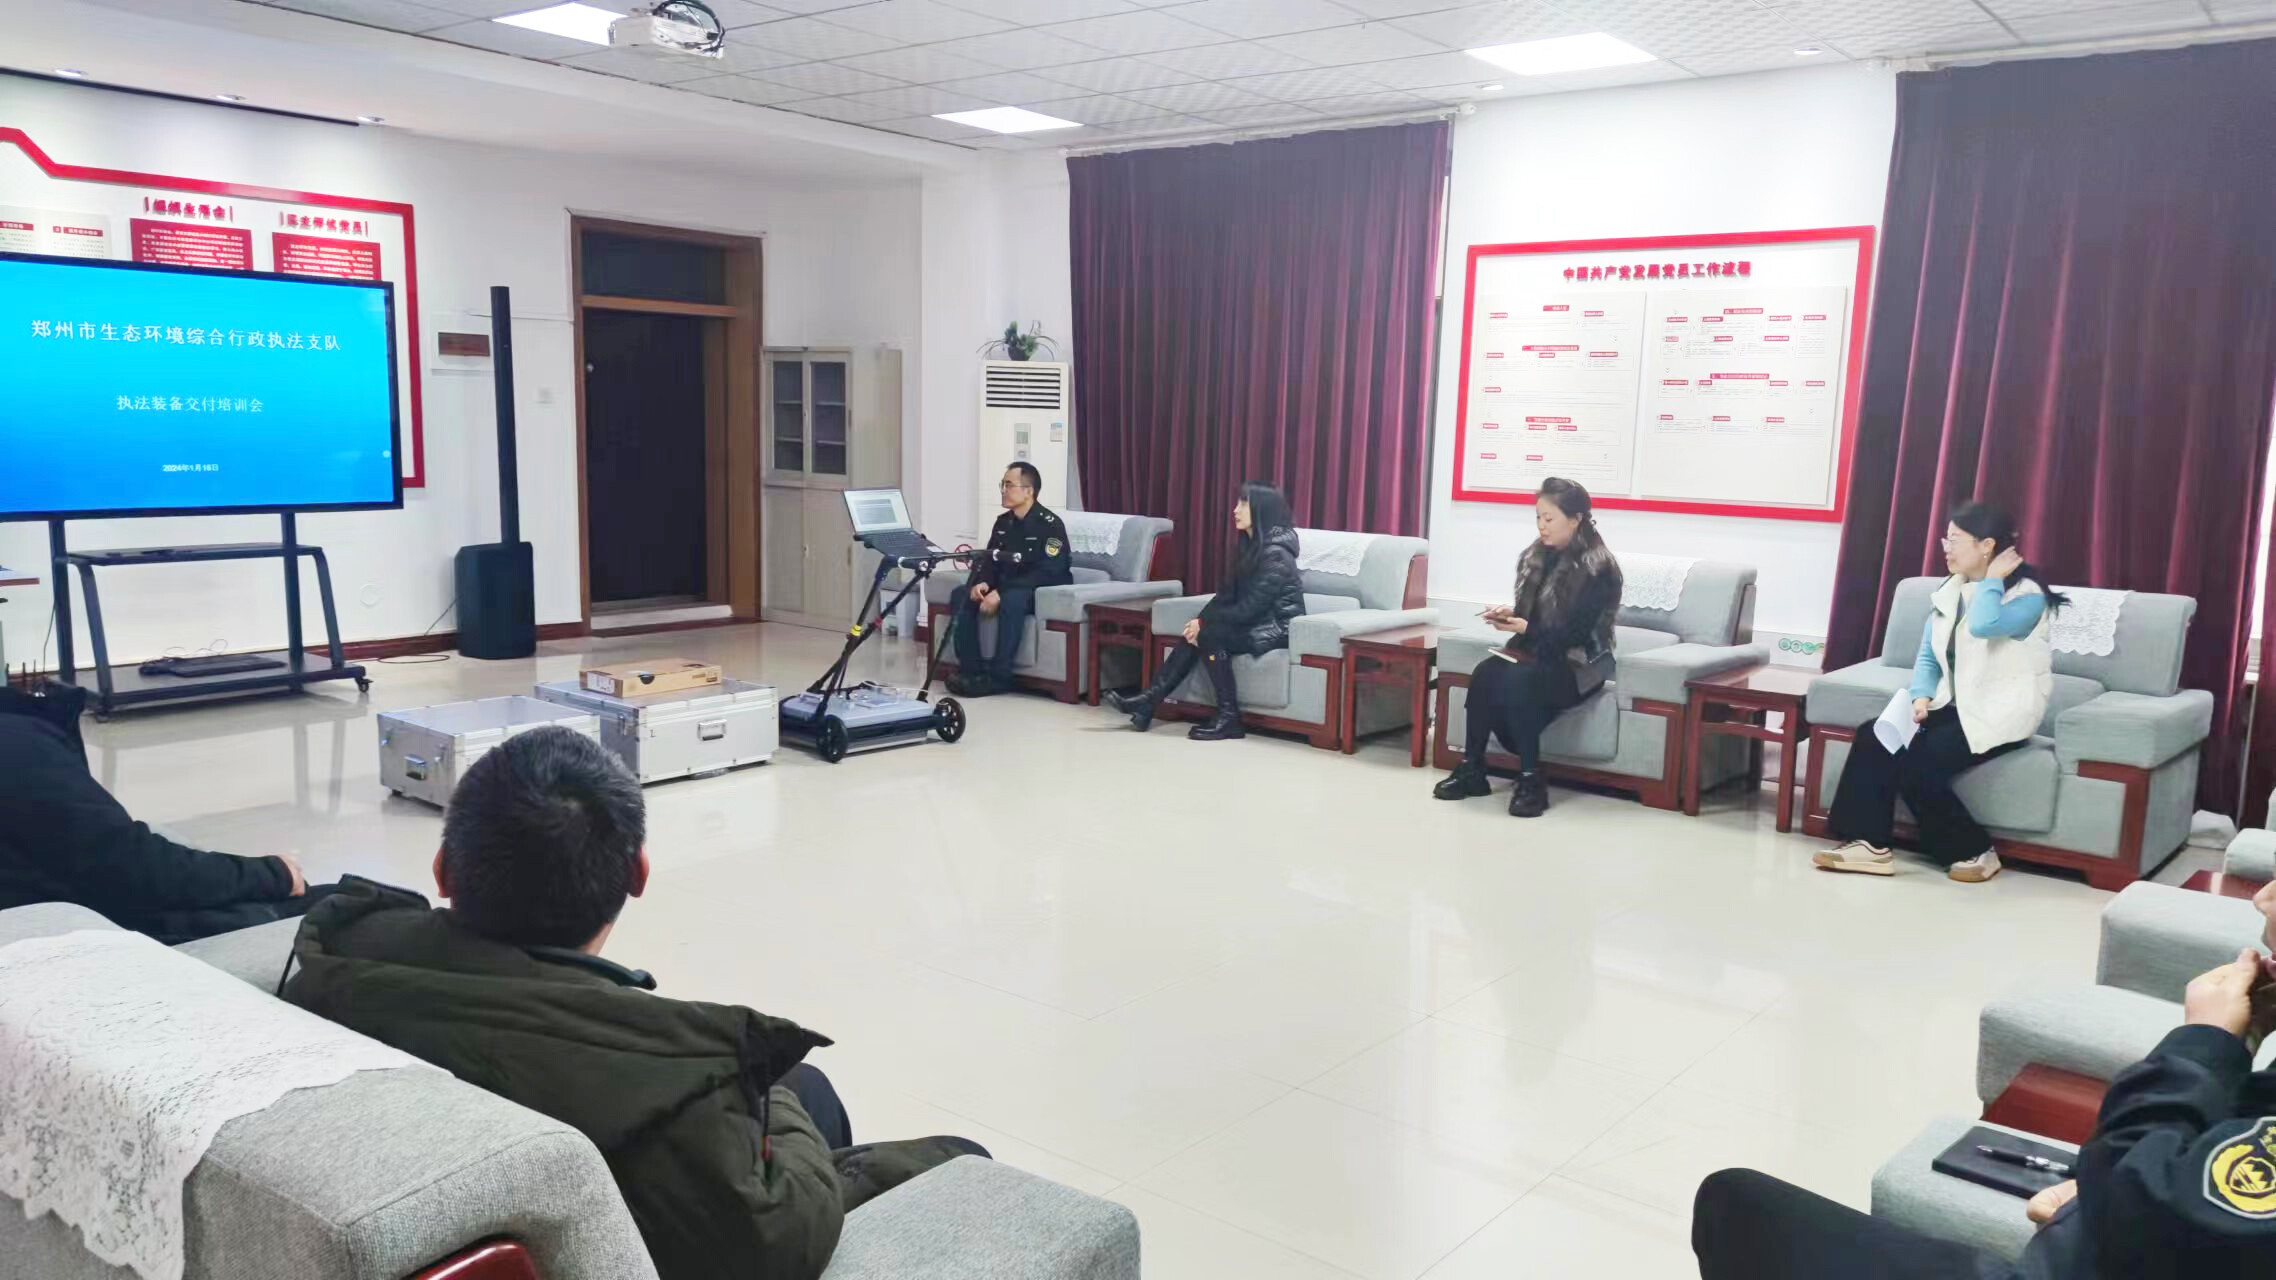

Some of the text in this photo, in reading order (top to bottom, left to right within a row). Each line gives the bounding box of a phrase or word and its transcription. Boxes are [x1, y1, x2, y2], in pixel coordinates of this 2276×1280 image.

[1563, 261, 1751, 281] 中国共产党发展党员工作流程
[31, 319, 341, 351] 郑州市生态环境综合行政执法支队
[116, 394, 264, 412] 执法装备交付培训会
